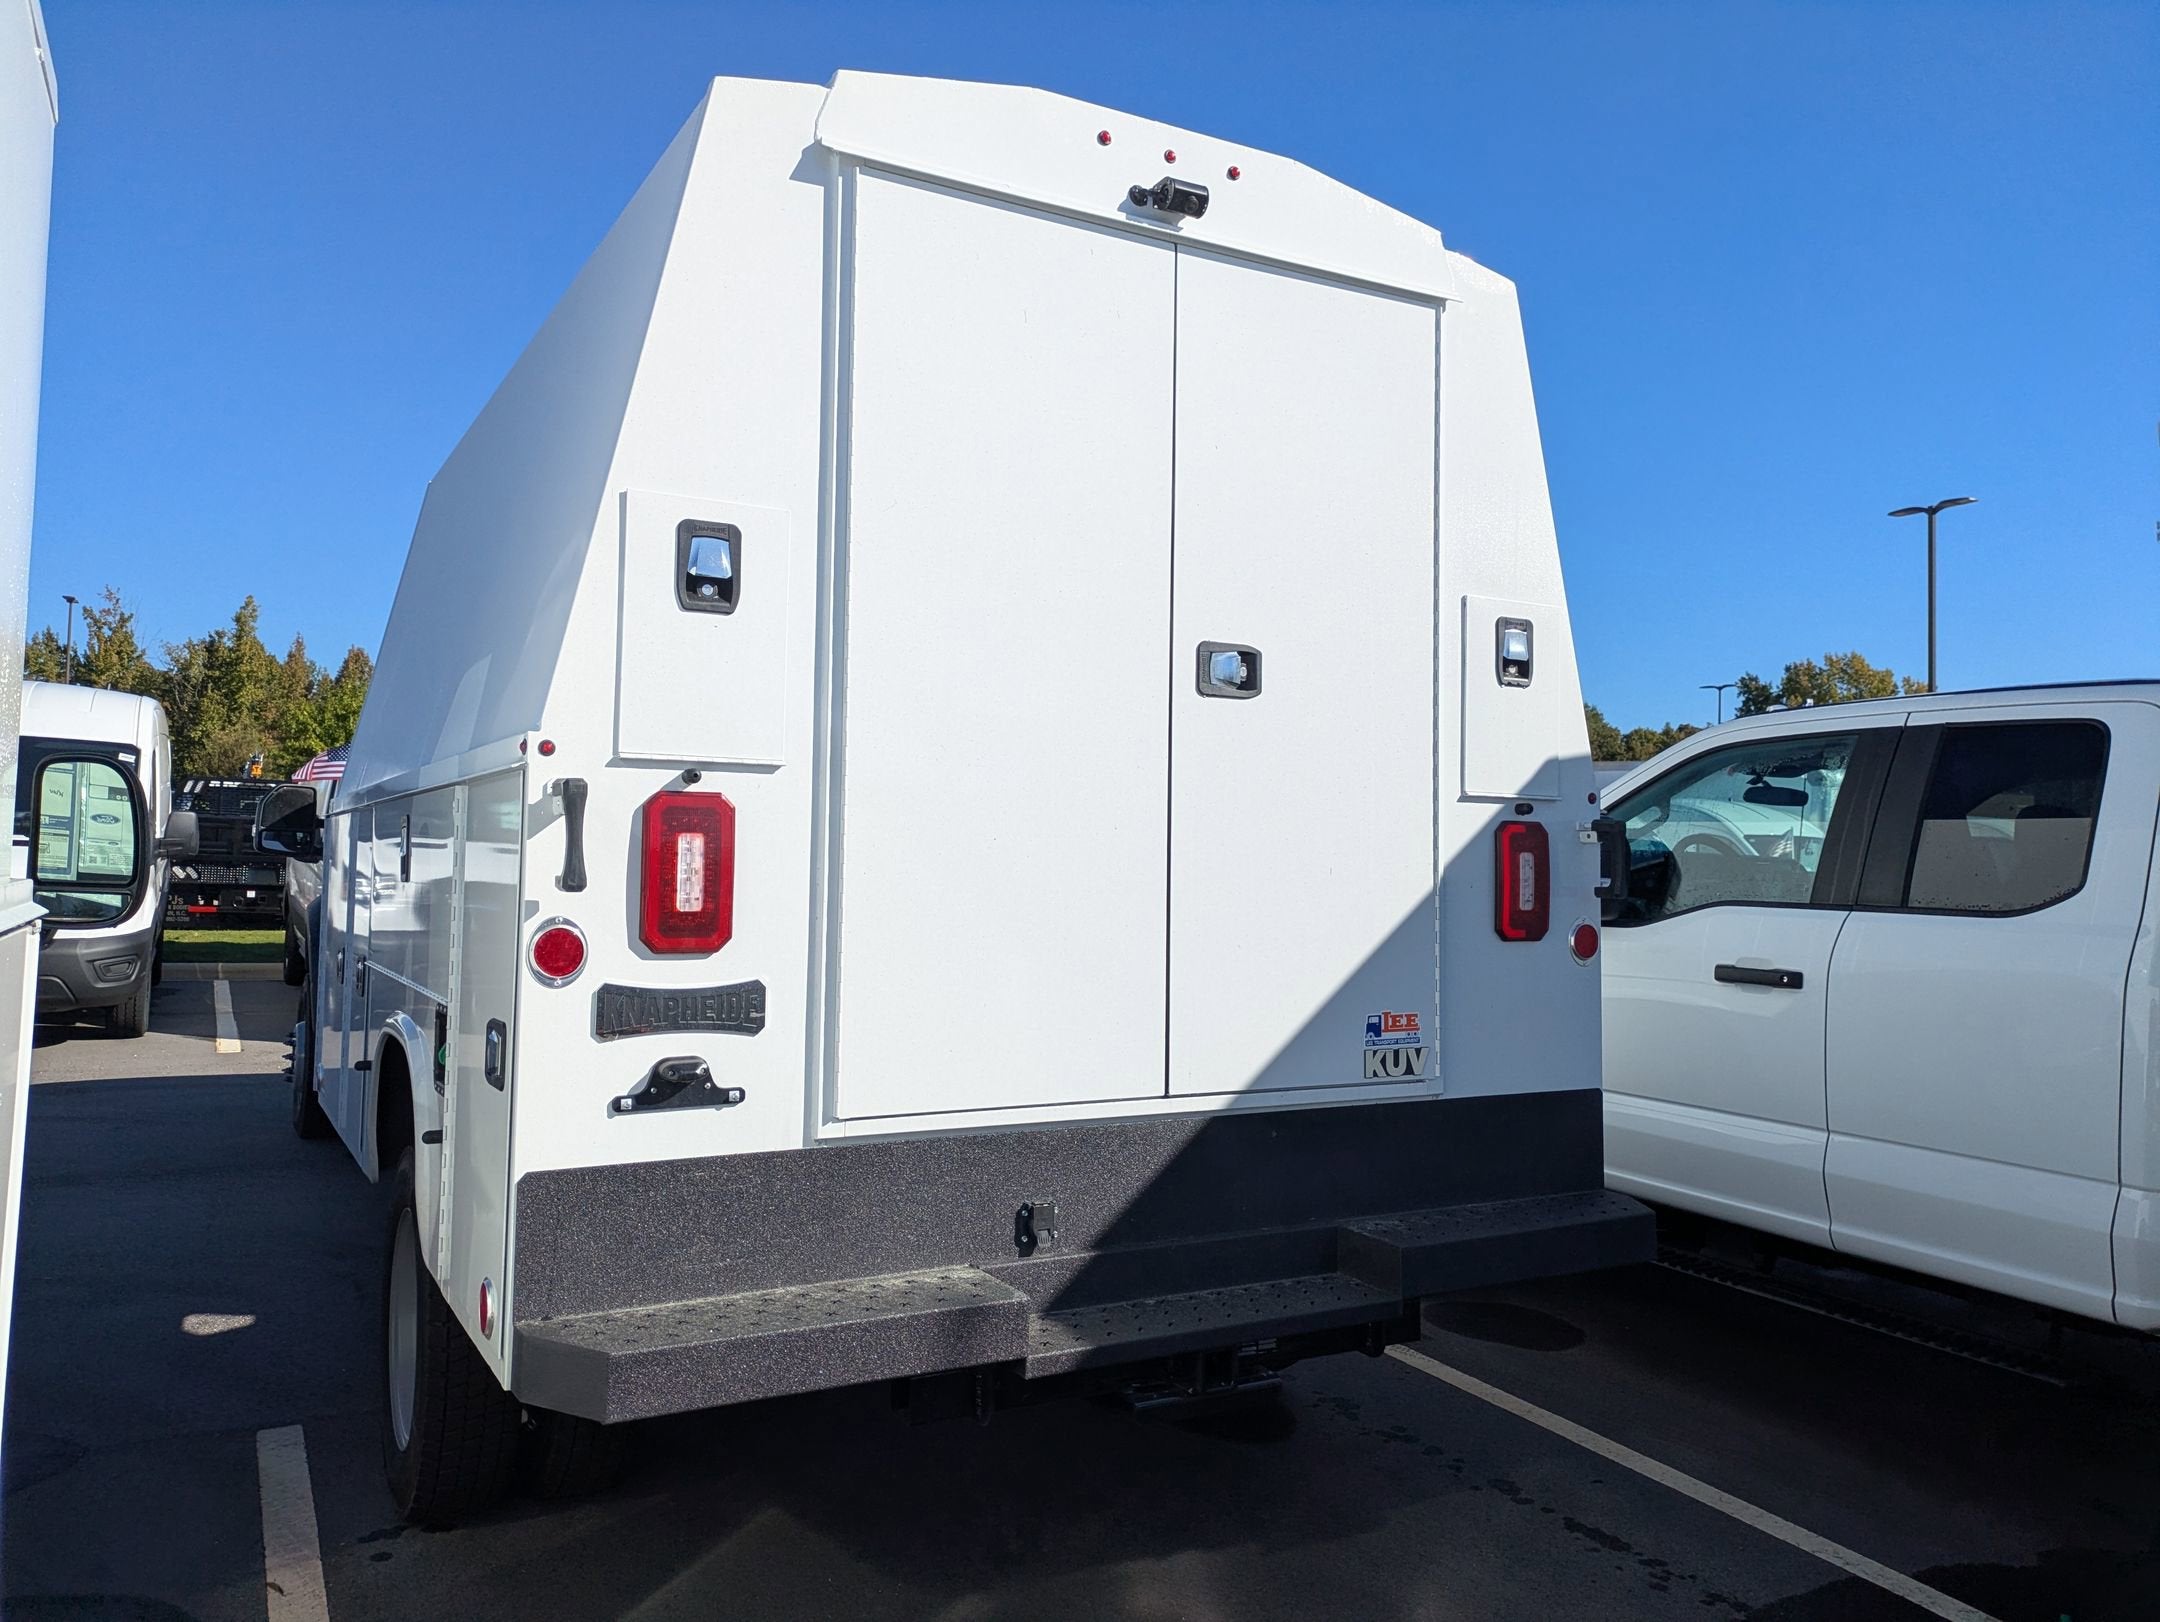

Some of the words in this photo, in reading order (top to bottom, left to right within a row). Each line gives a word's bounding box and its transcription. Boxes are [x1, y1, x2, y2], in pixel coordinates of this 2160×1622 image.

[604, 989, 764, 1032] KNAPHEIDE
[1382, 1011, 1420, 1033] LEE
[1364, 1047, 1430, 1079] KUV
